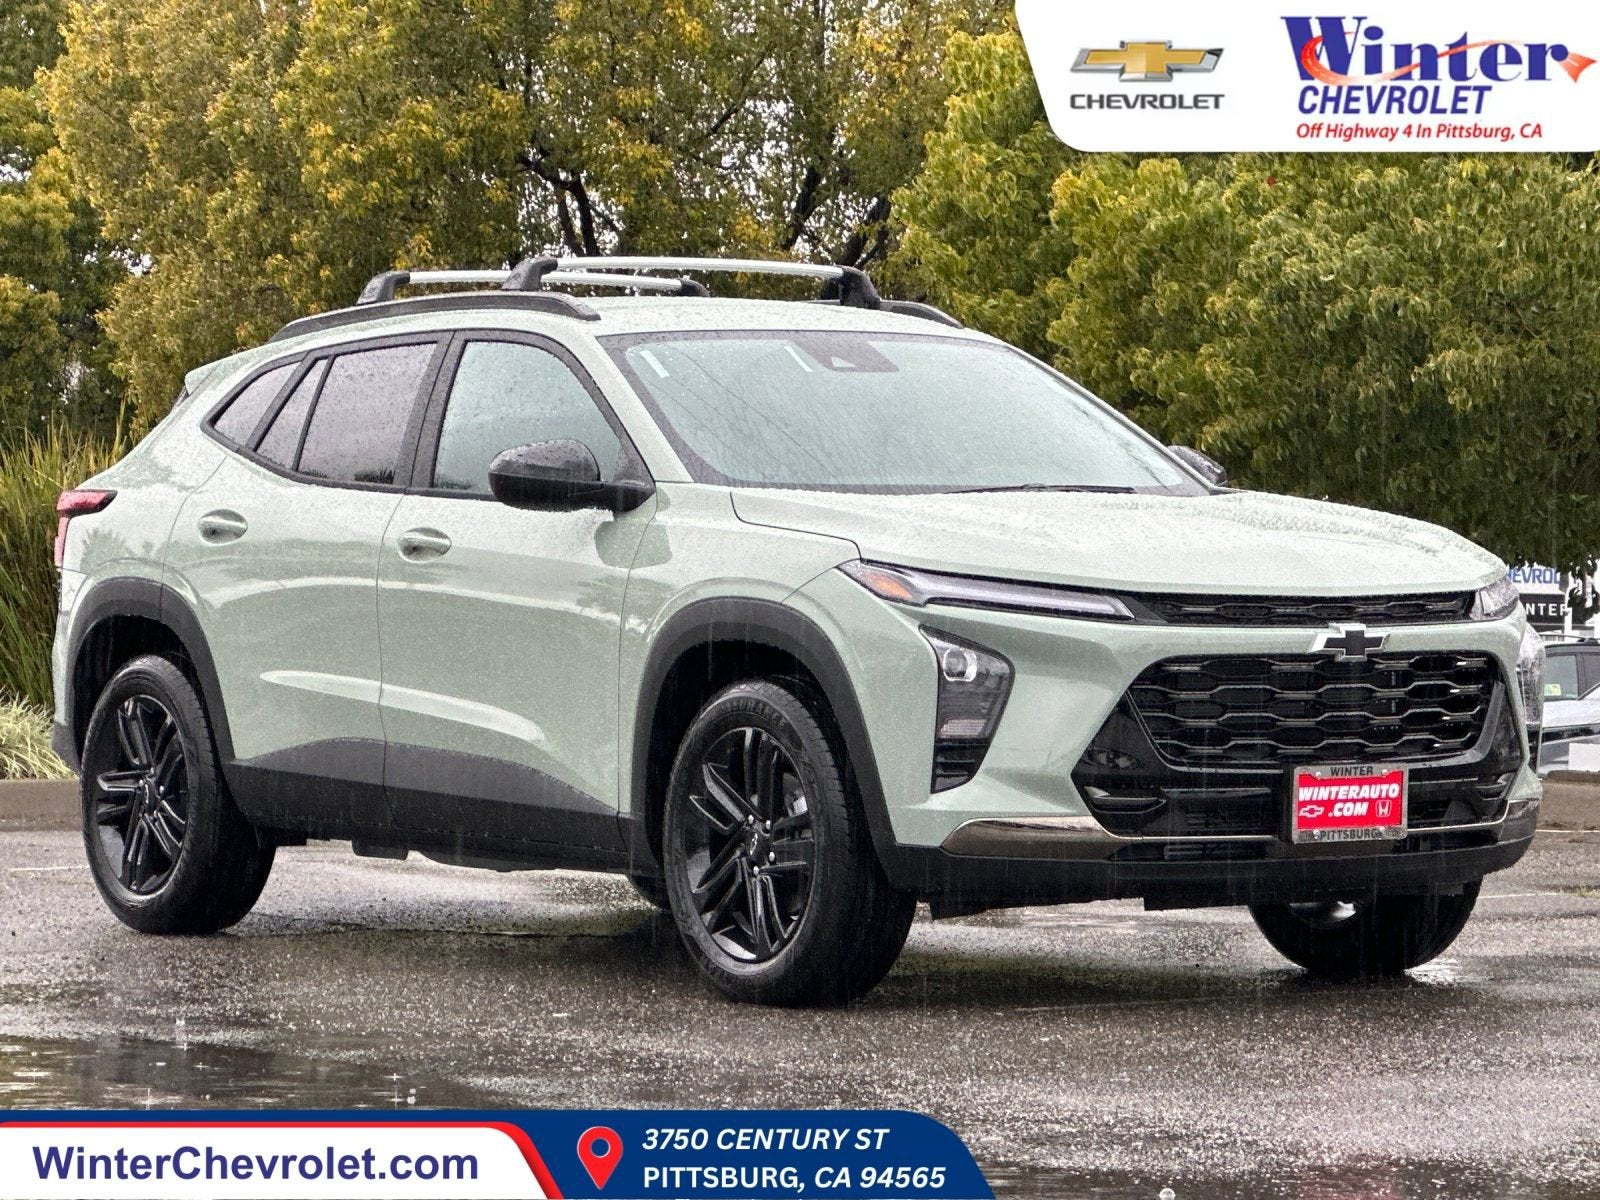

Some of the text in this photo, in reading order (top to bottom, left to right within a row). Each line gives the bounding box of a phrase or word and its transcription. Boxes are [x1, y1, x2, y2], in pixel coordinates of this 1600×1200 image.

[1330, 766, 1374, 777] WINTER
[1299, 783, 1400, 801] WINTERAUTO
[1328, 802, 1369, 818] .COM
[1318, 828, 1382, 840] PITTSBURG
